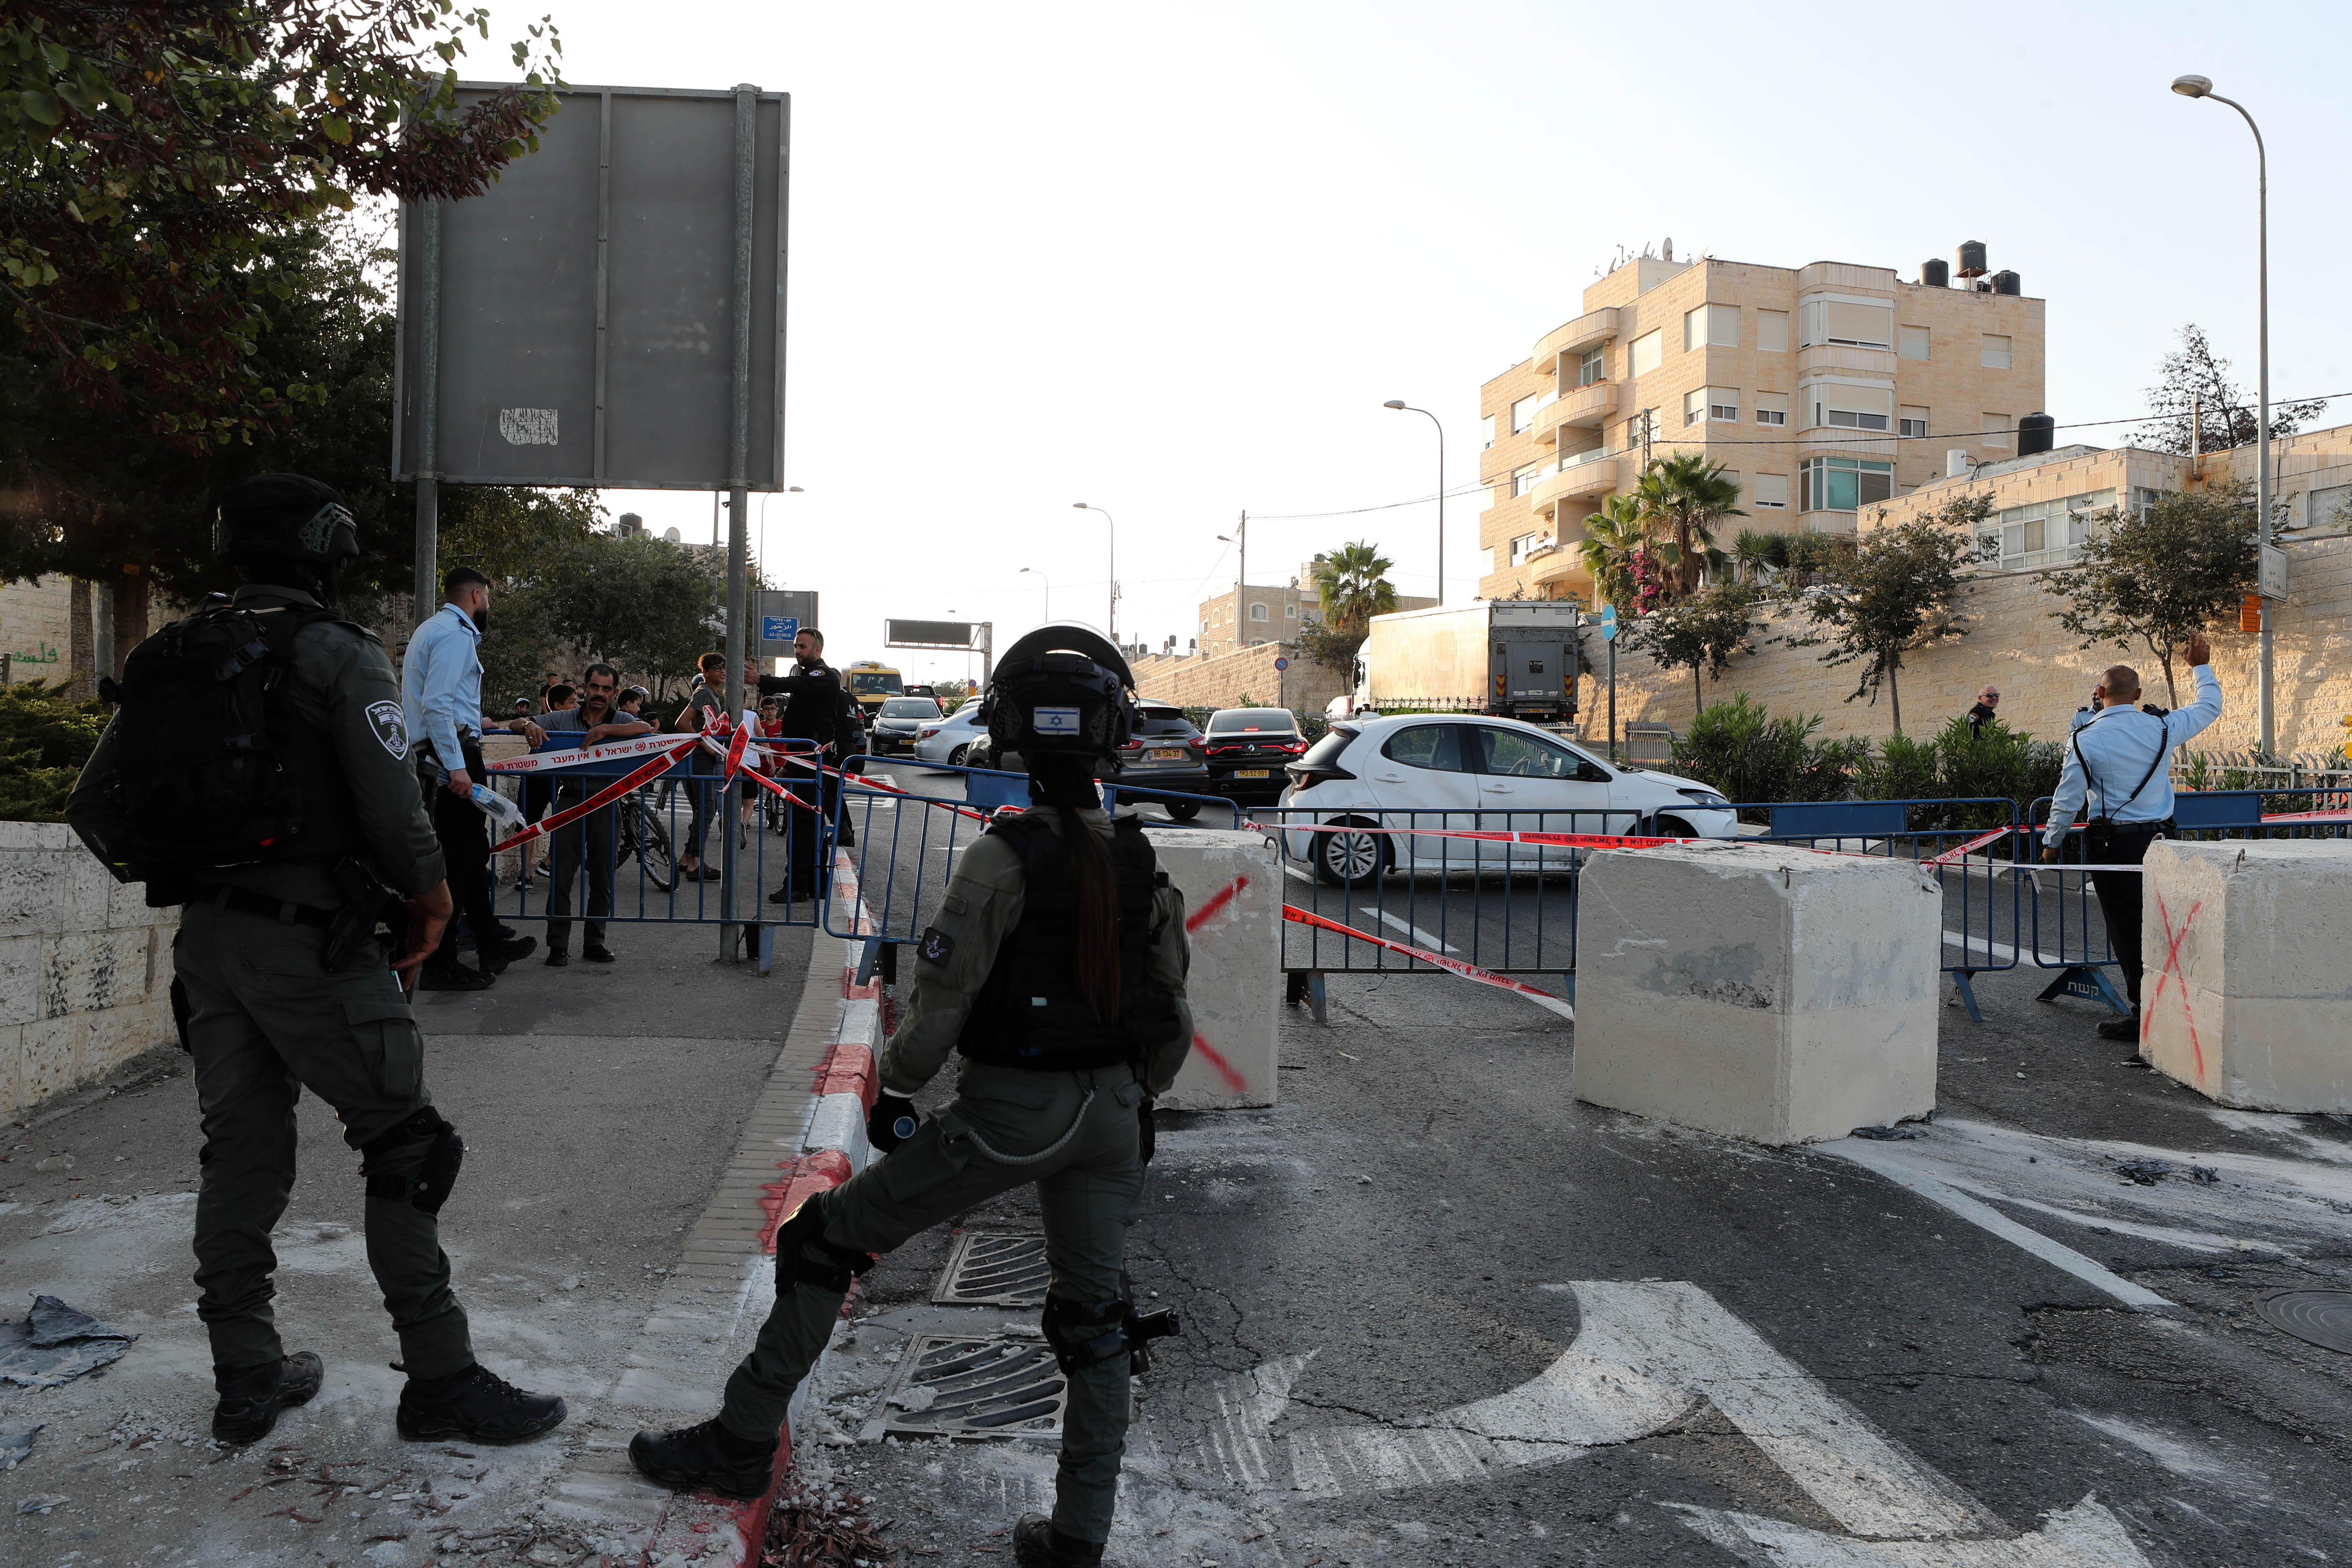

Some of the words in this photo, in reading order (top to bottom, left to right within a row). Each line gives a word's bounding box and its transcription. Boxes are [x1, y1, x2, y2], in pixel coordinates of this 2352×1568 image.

[605, 746, 632, 756] ישראל
[551, 754, 575, 764] מעבר
[577, 753, 589, 762] אין
[506, 760, 538, 770] משטרת
[635, 760, 666, 782] משטרת
[1580, 835, 1611, 846] ישראל
[1939, 850, 1960, 863] שראל
[1436, 959, 1462, 973] ישראל
[1489, 974, 1510, 985] מעבר
[2067, 981, 2099, 998] קשת
